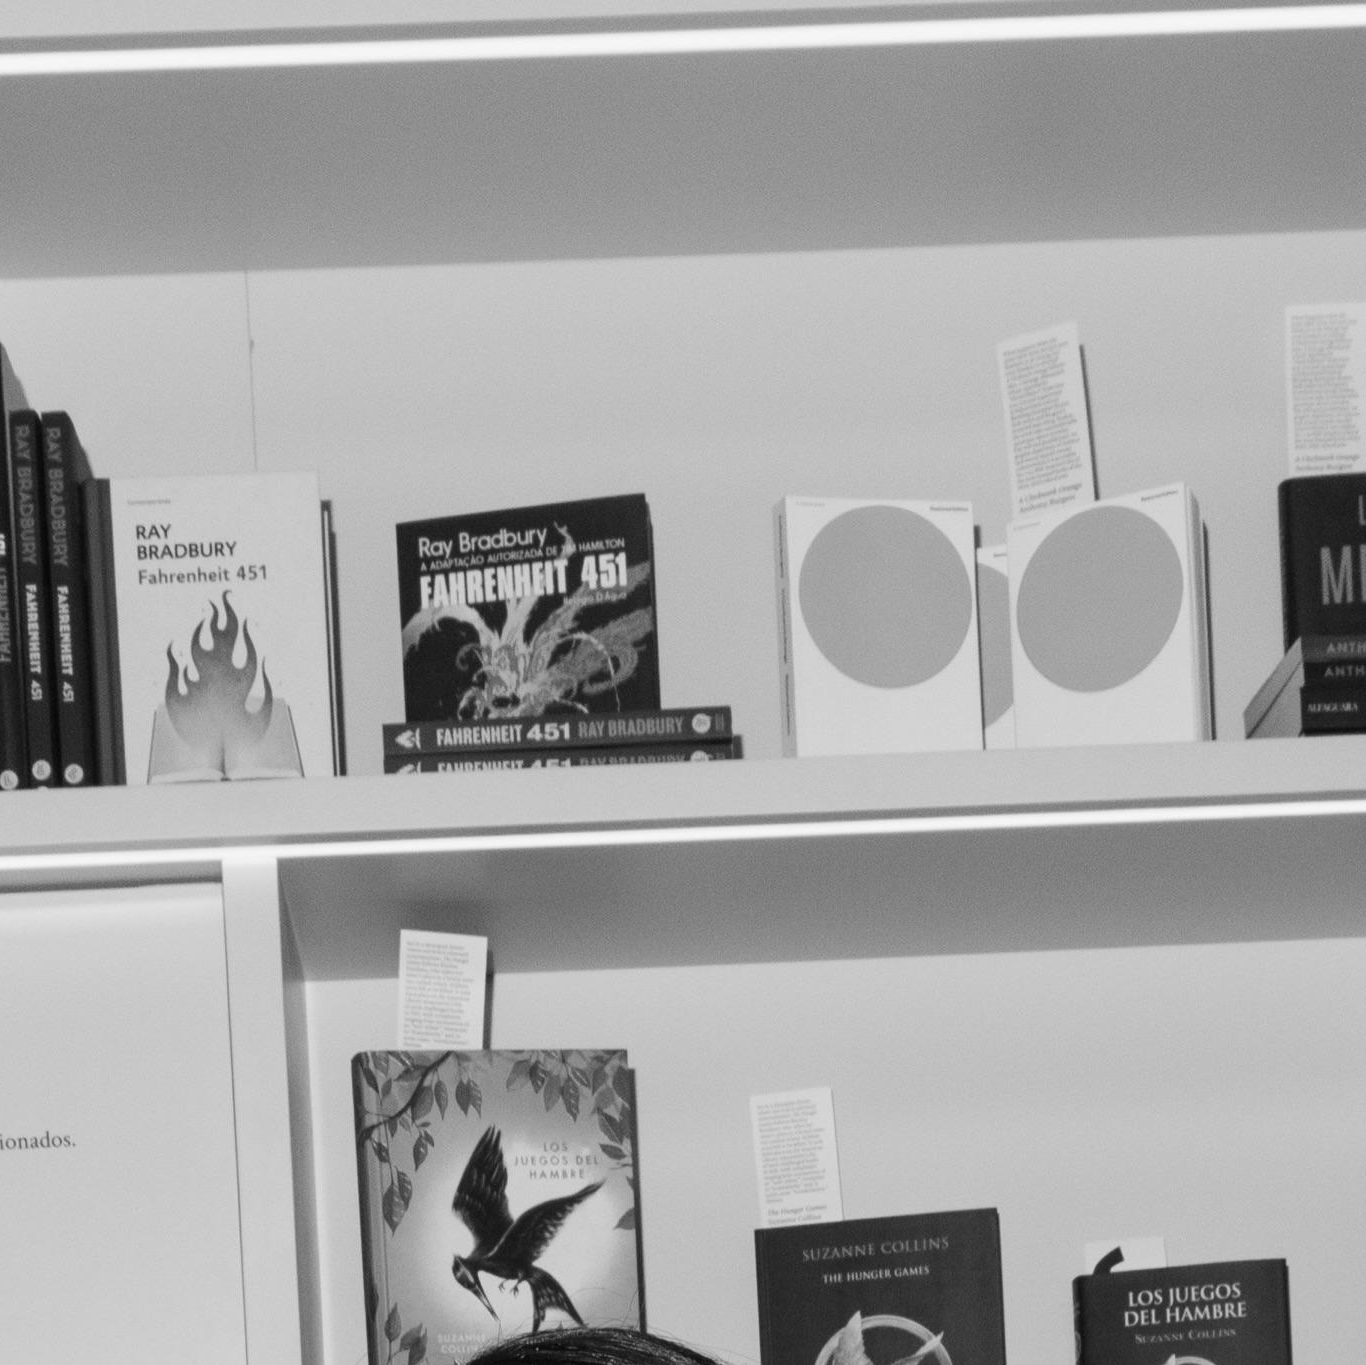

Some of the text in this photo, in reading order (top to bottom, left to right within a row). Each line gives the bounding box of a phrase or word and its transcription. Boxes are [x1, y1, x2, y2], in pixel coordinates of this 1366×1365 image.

[135, 524, 171, 541] RAY
[418, 528, 552, 560] Ray Bradbury
[137, 540, 236, 560] BRADBURY
[138, 564, 266, 585] Fahrenheit 451
[420, 552, 628, 610] FAHRENHEIT 451
[436, 718, 681, 746] FAHRENHEIT 451 RAY BRADBURY
[802, 1236, 949, 1261] SUZANNE COLLINS
[1128, 1282, 1241, 1307] LOS JUEGOS
[1124, 1301, 1246, 1327] DEL HAMBRE
